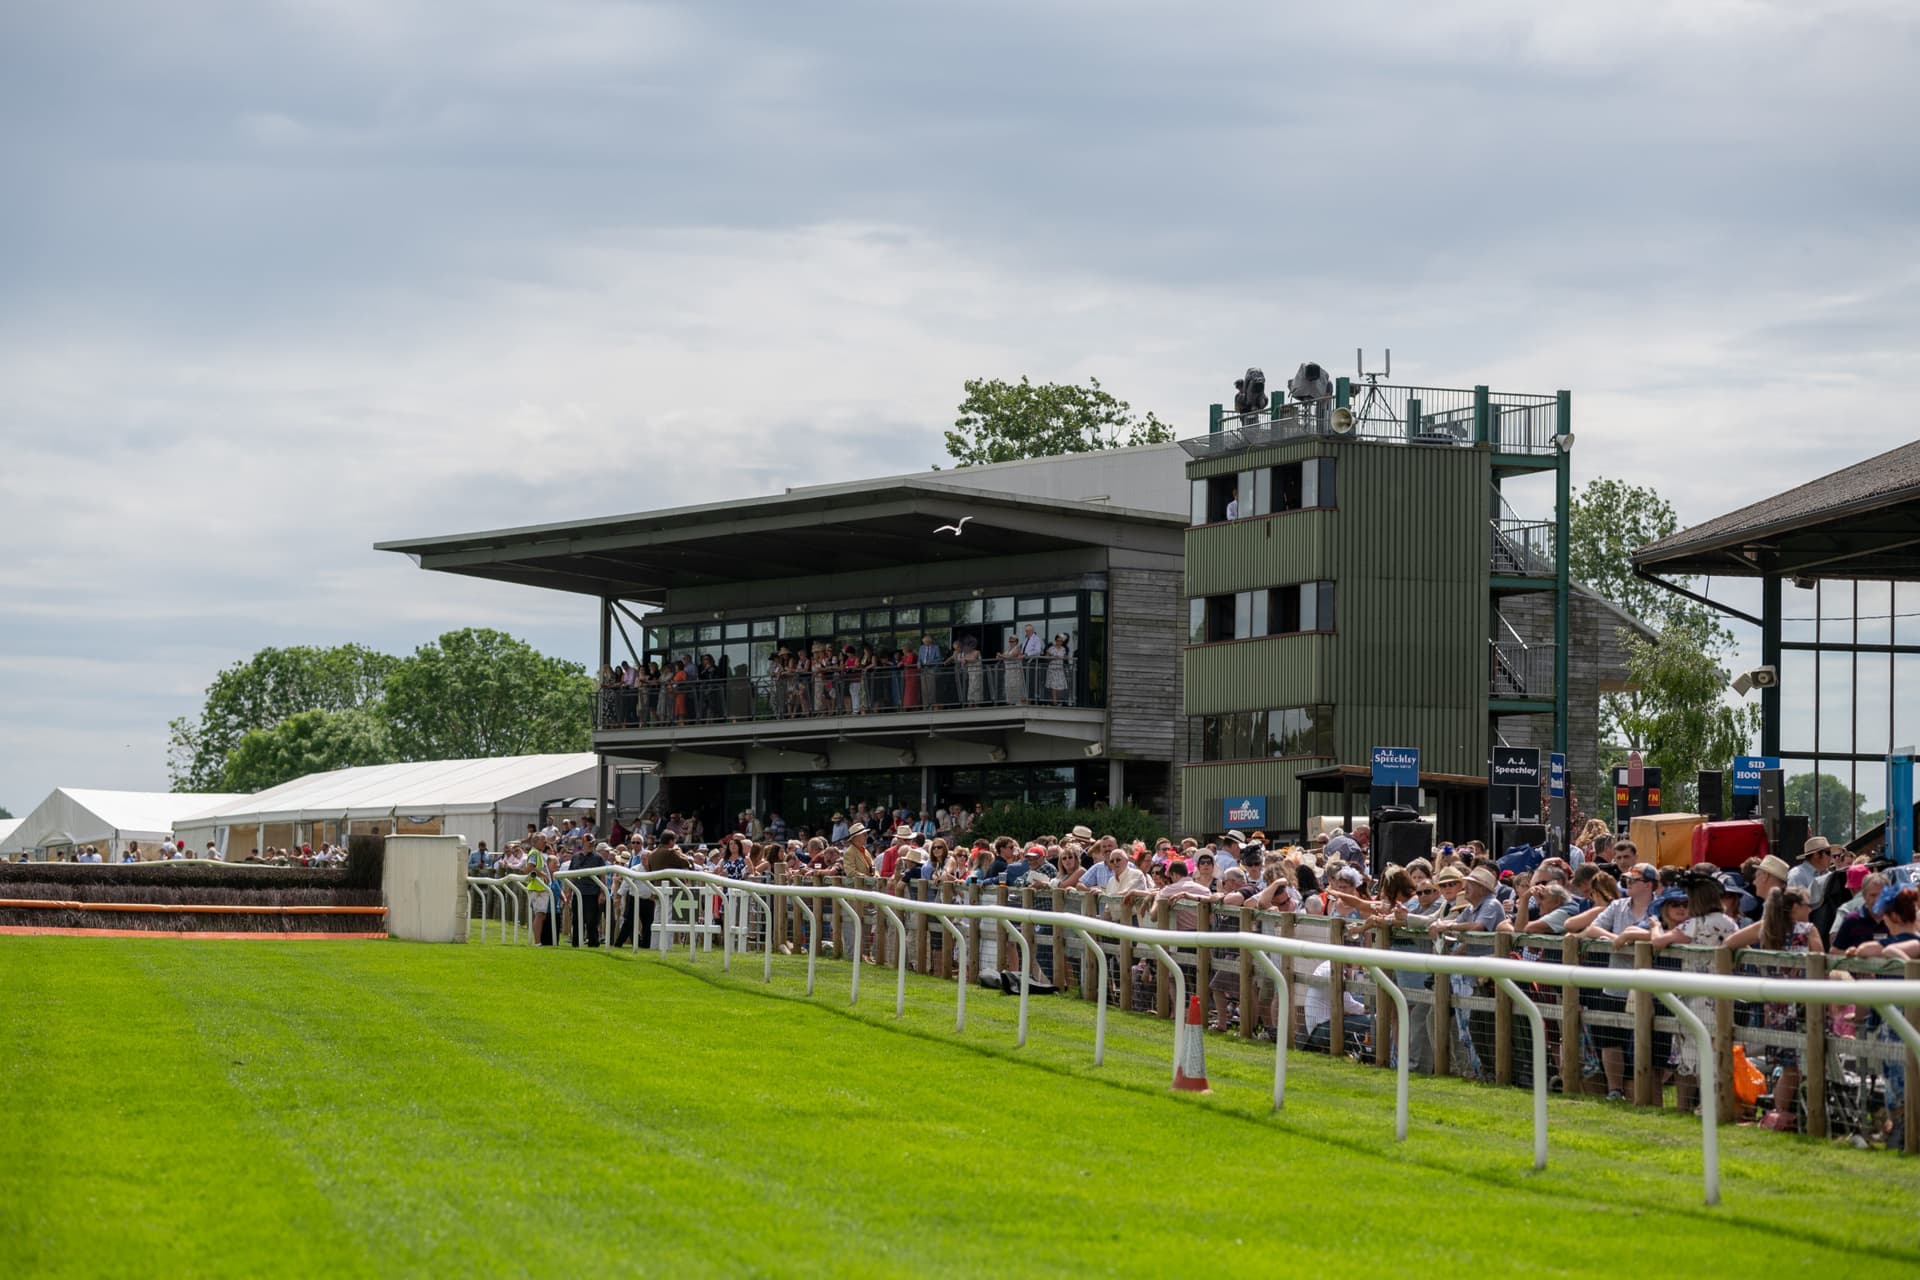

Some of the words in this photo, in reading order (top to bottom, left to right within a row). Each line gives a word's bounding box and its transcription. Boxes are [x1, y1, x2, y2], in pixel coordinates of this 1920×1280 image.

[1748, 760, 1765, 769] SID
[1495, 766, 1537, 776] Speechley
[1736, 771, 1761, 779] HOO
[1229, 809, 1259, 821] TOTEPOOL
